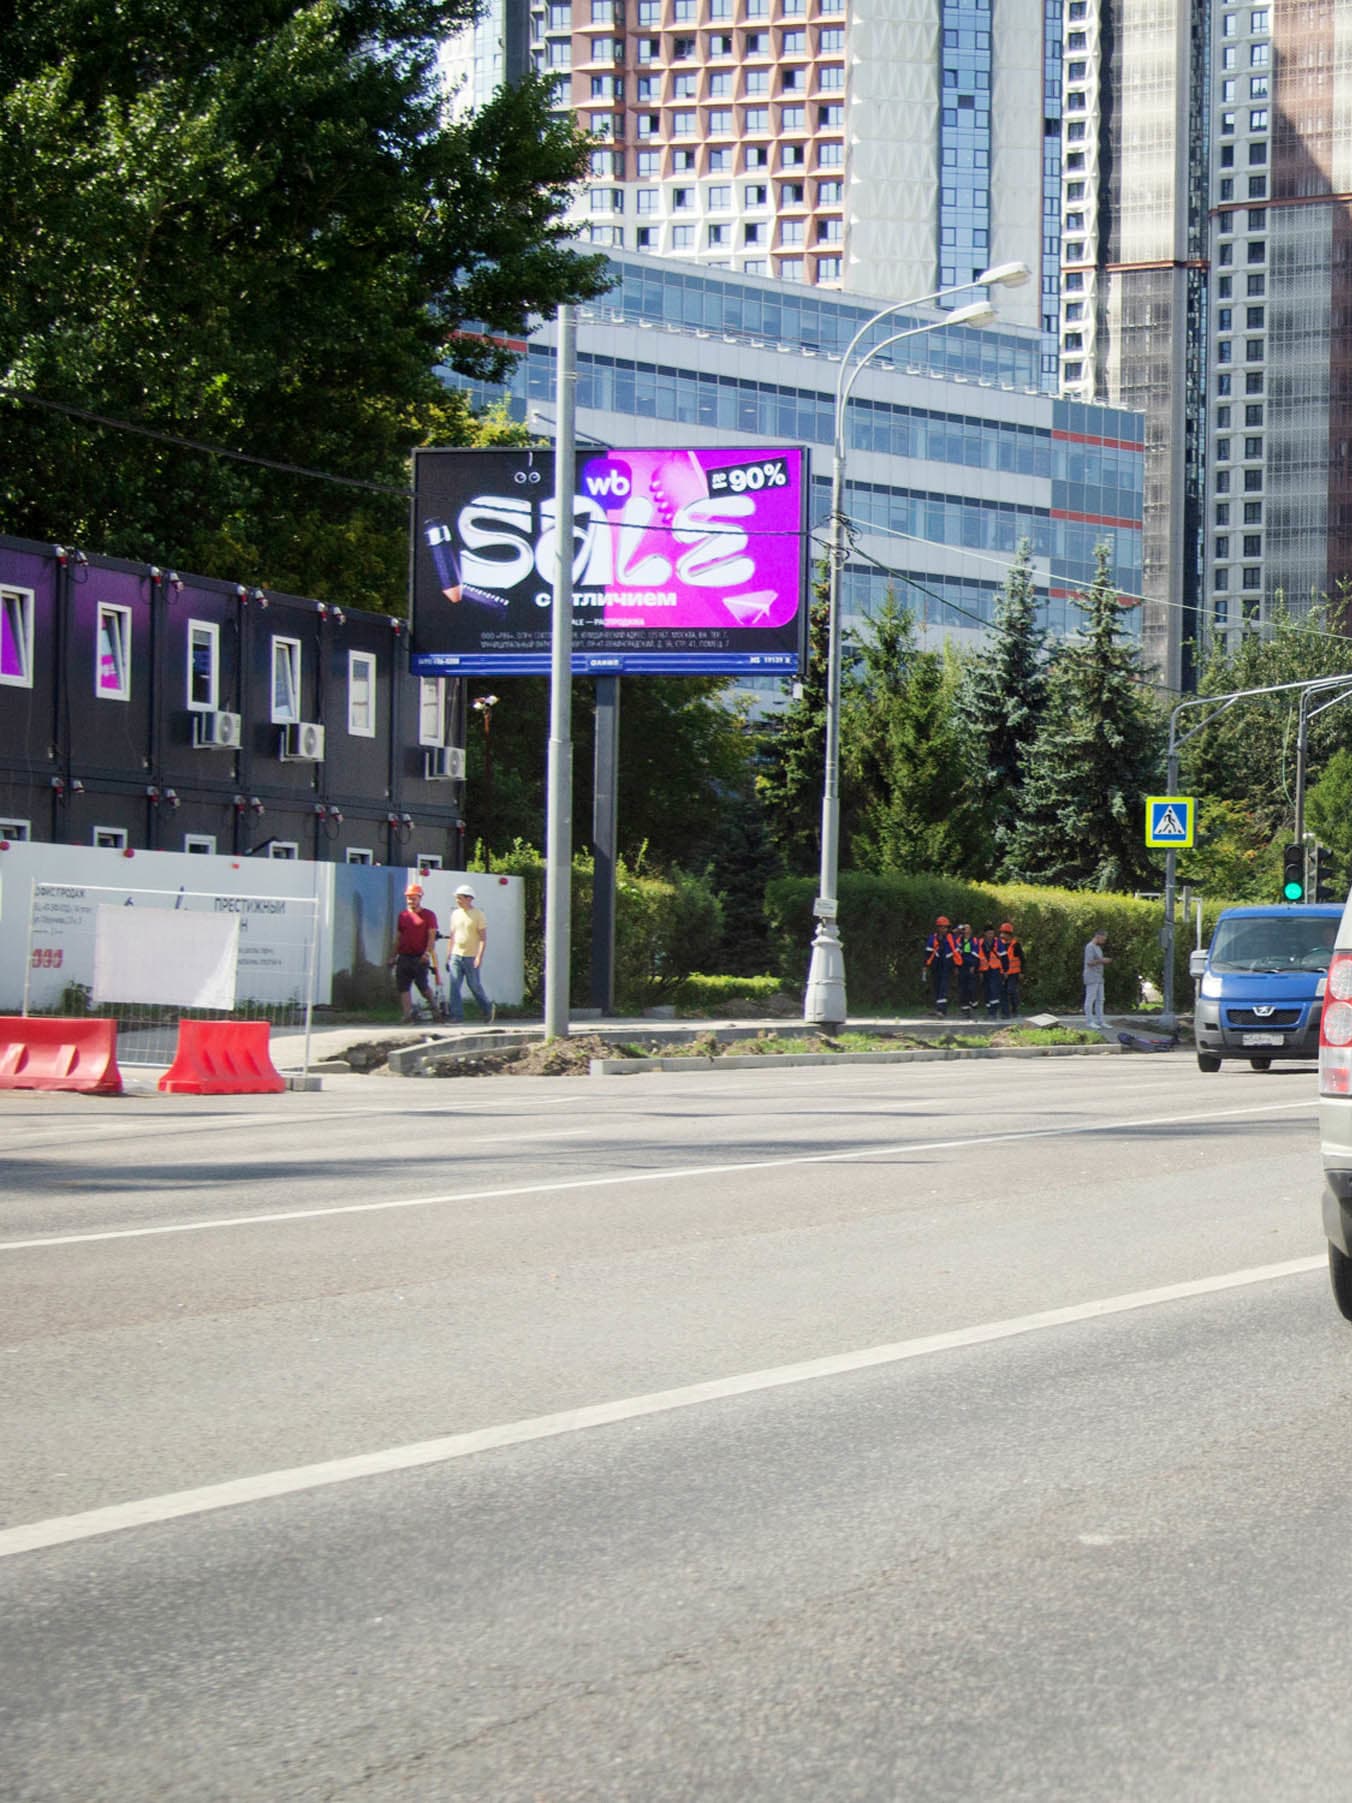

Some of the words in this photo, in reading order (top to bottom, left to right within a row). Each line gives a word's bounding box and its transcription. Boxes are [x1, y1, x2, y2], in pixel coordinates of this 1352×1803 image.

[586, 470, 631, 496] wb
[729, 462, 787, 492] 90%
[571, 592, 677, 607] тличием
[214, 897, 286, 914] ПРЕСТИЖНЫЙ
